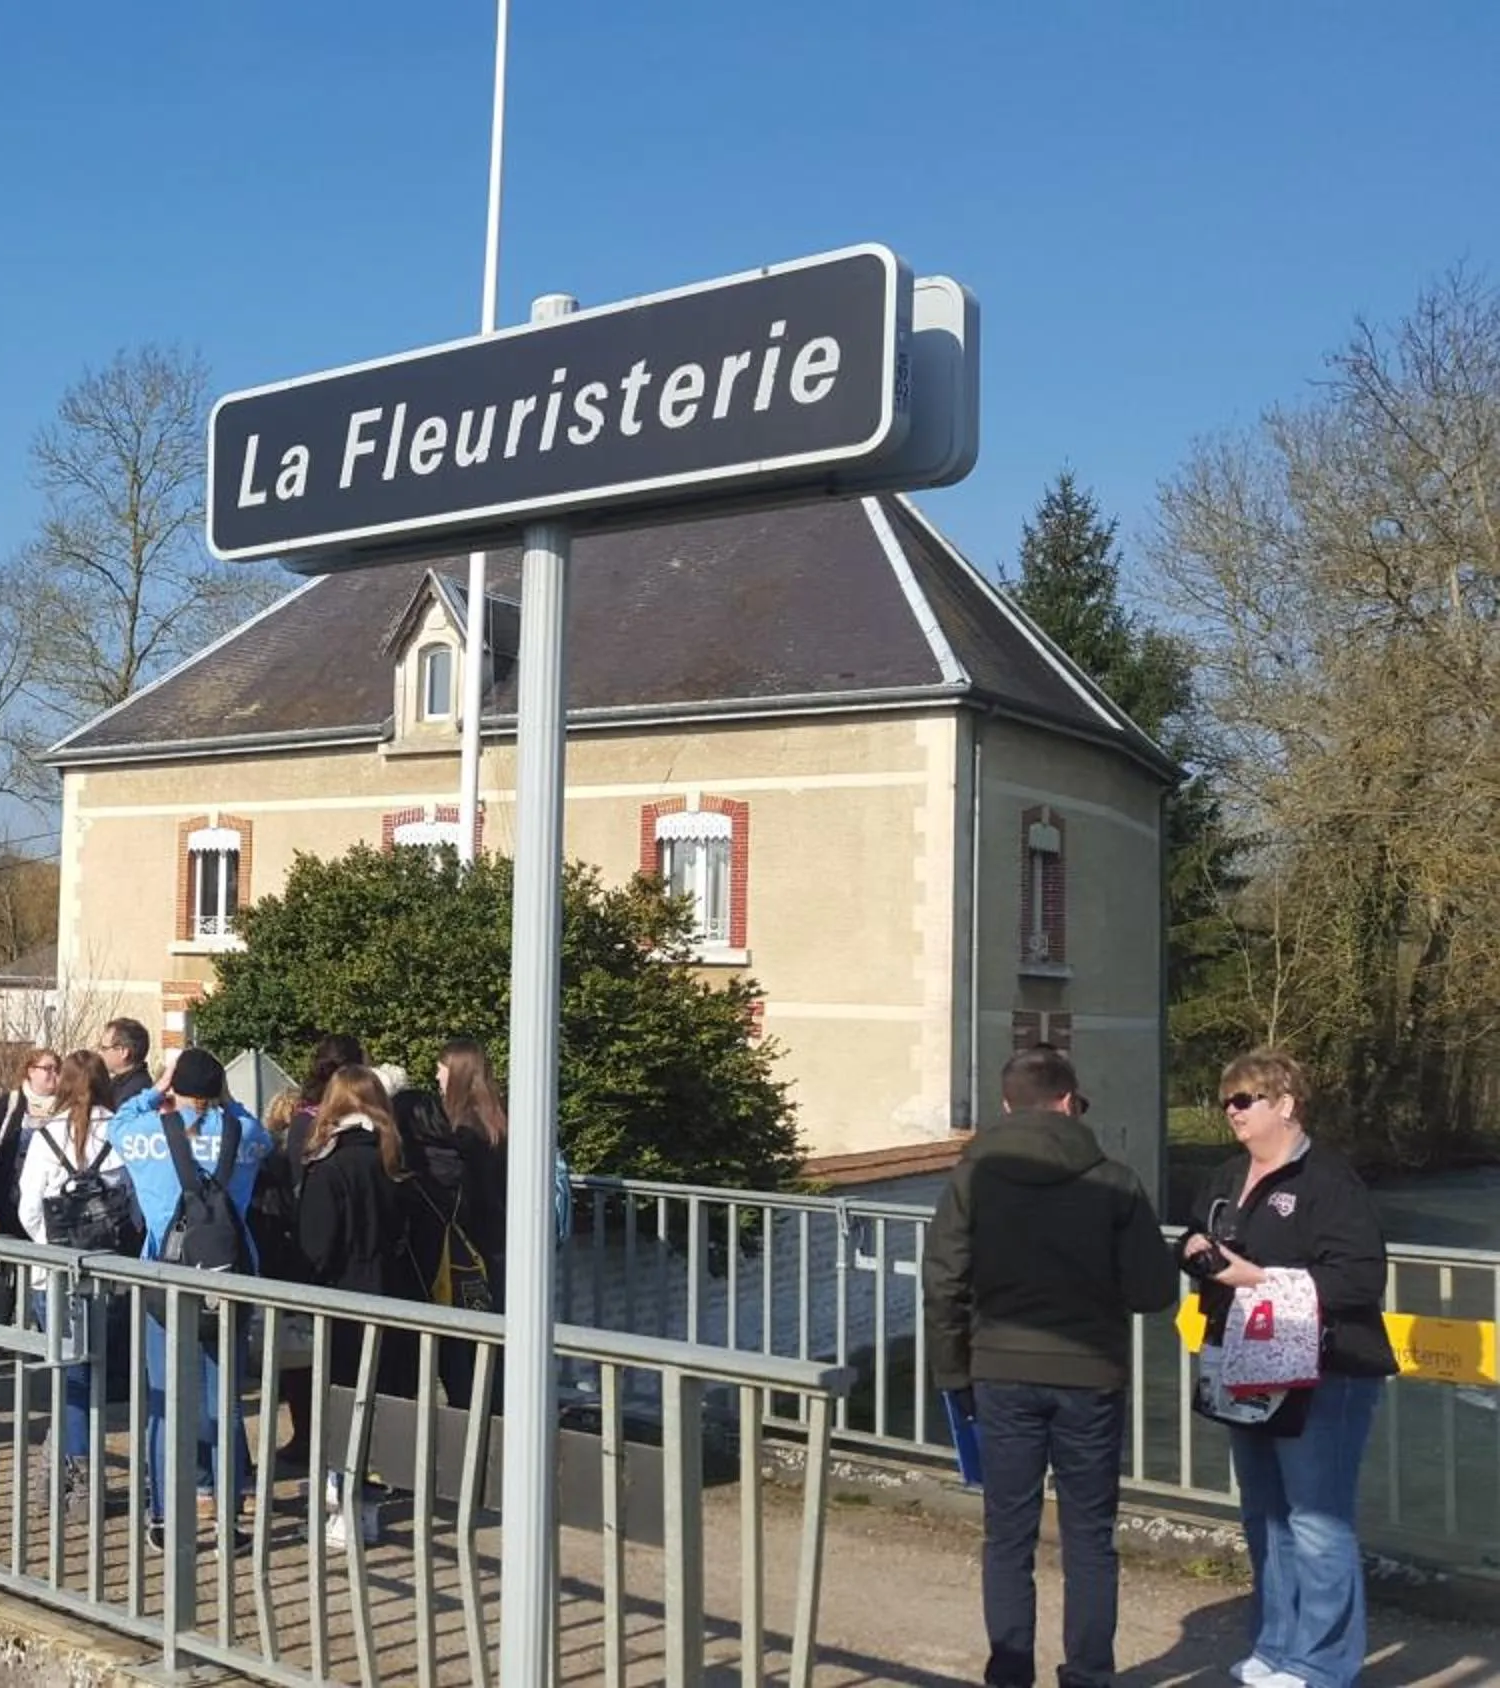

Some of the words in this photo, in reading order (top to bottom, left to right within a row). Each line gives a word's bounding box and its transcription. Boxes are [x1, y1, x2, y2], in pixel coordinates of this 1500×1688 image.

[237, 433, 310, 508] La
[339, 319, 842, 490] Fleuristerie
[122, 1133, 223, 1161] SOCER
